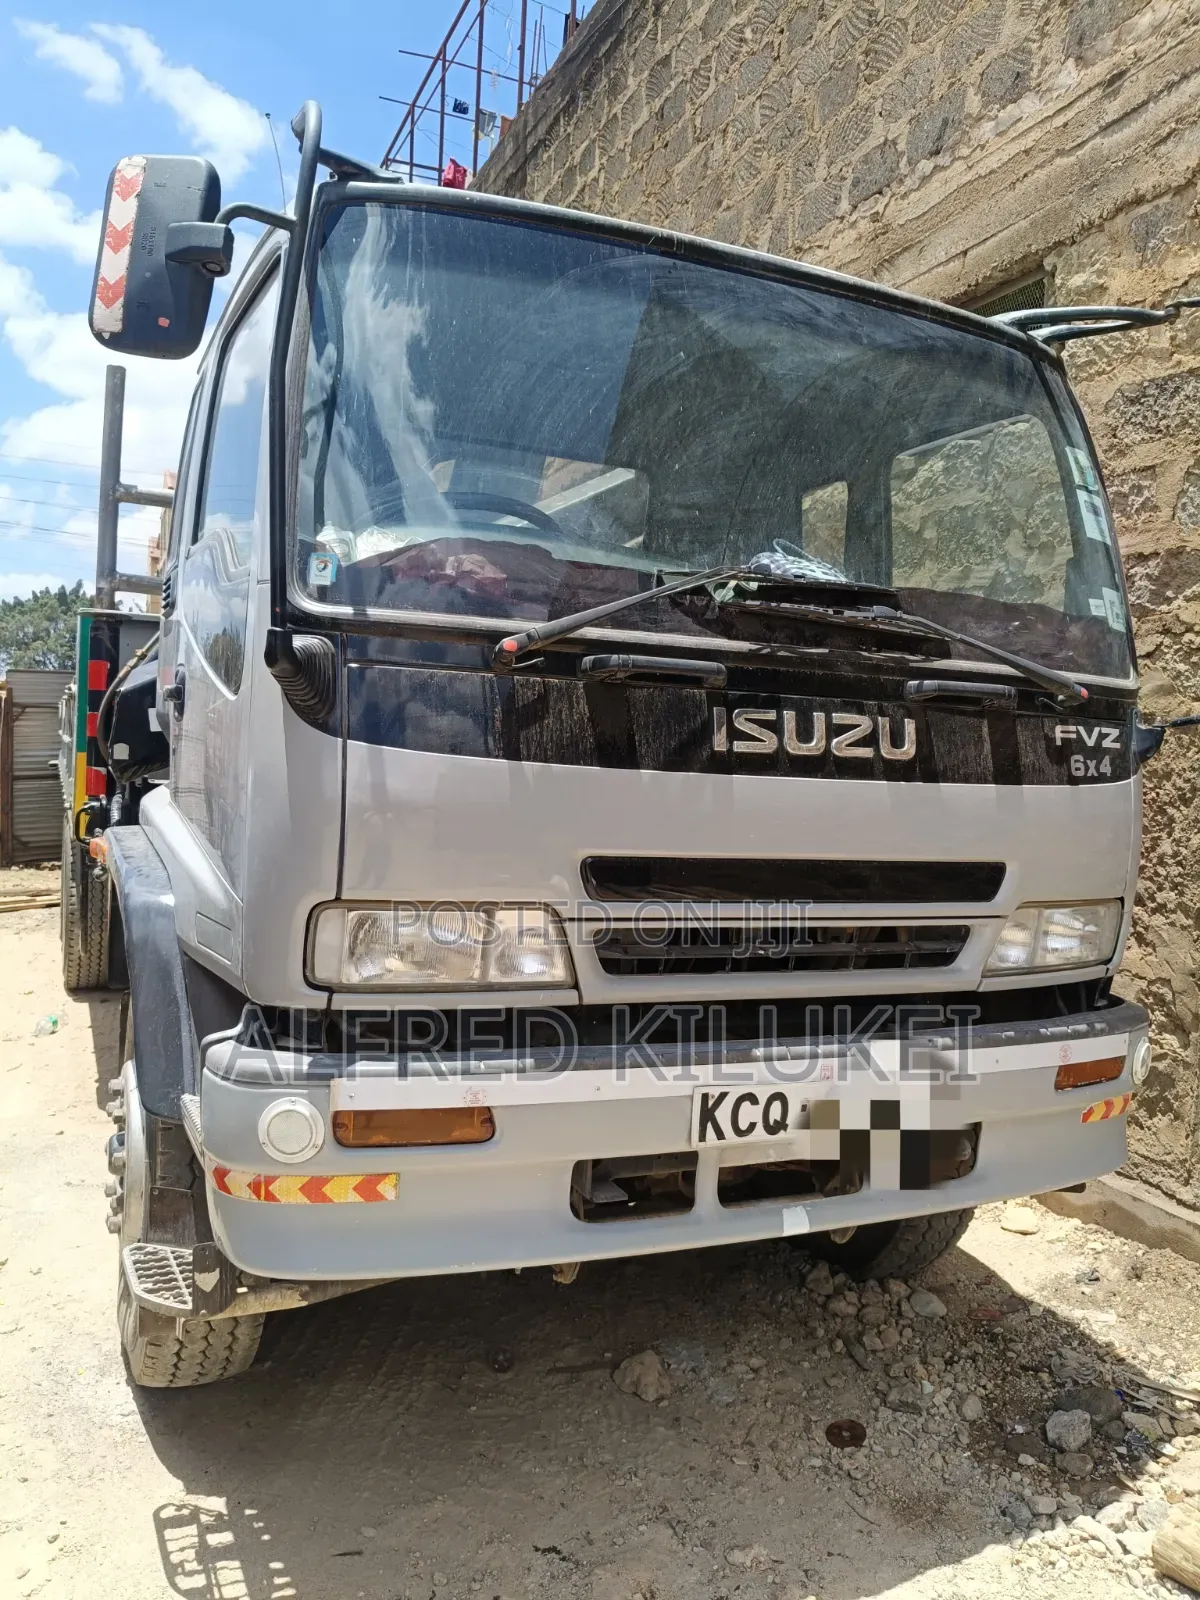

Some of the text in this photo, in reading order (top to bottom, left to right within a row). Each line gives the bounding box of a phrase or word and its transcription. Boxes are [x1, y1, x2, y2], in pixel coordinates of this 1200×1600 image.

[712, 706, 917, 760] ISUZU
[1054, 724, 1121, 749] FVZ
[1070, 754, 1112, 777] 6x4
[698, 1091, 790, 1143] KCQ
